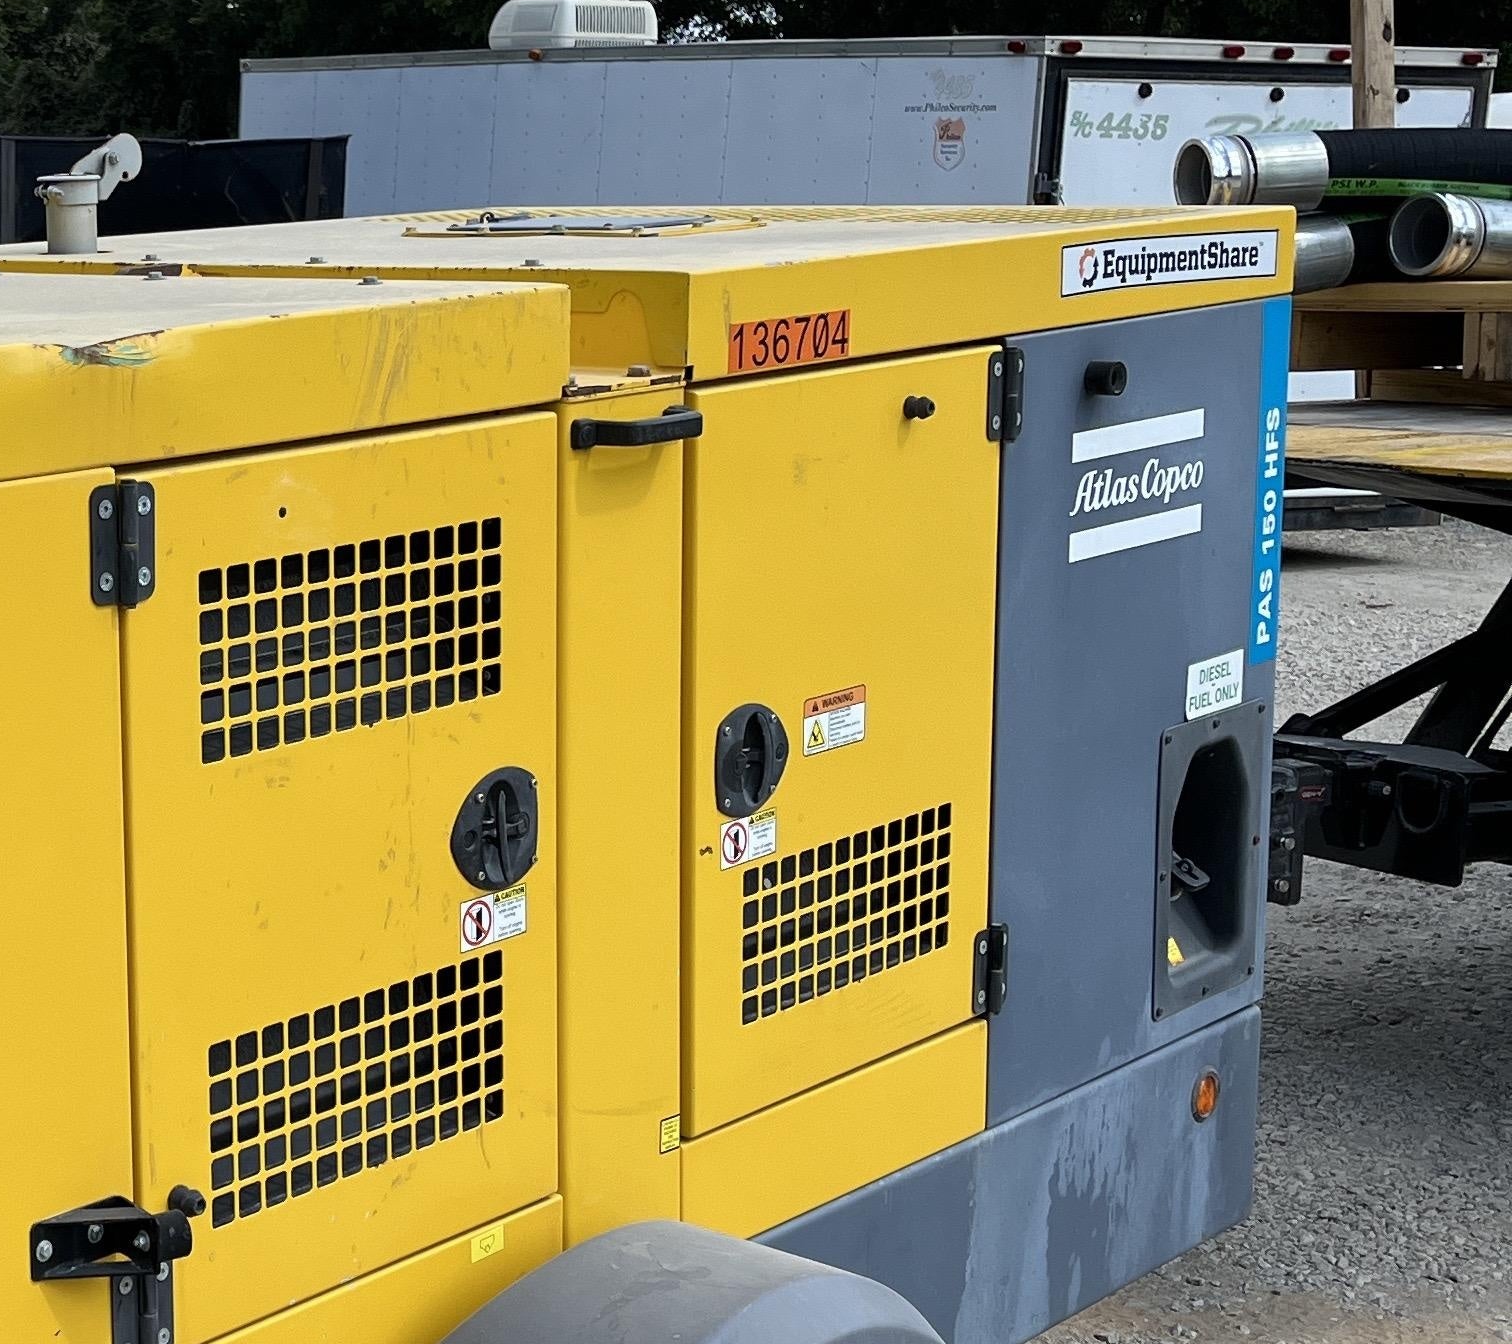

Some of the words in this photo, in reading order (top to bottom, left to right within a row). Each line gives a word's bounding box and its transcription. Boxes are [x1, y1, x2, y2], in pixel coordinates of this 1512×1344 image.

[1095, 111, 1169, 141] 4435
[1331, 179, 1351, 189] PSI
[1102, 241, 1259, 282] EquipmentShare
[733, 311, 848, 369] 136704
[1264, 407, 1281, 479] HFS
[1261, 490, 1277, 556] 150
[1256, 568, 1273, 645] PAS
[1199, 661, 1232, 686] DIESEL
[821, 691, 854, 708] WARNING
[1189, 693, 1213, 711] FUEL
[1215, 681, 1240, 701] ONLY
[500, 886, 525, 900] CAUTION
